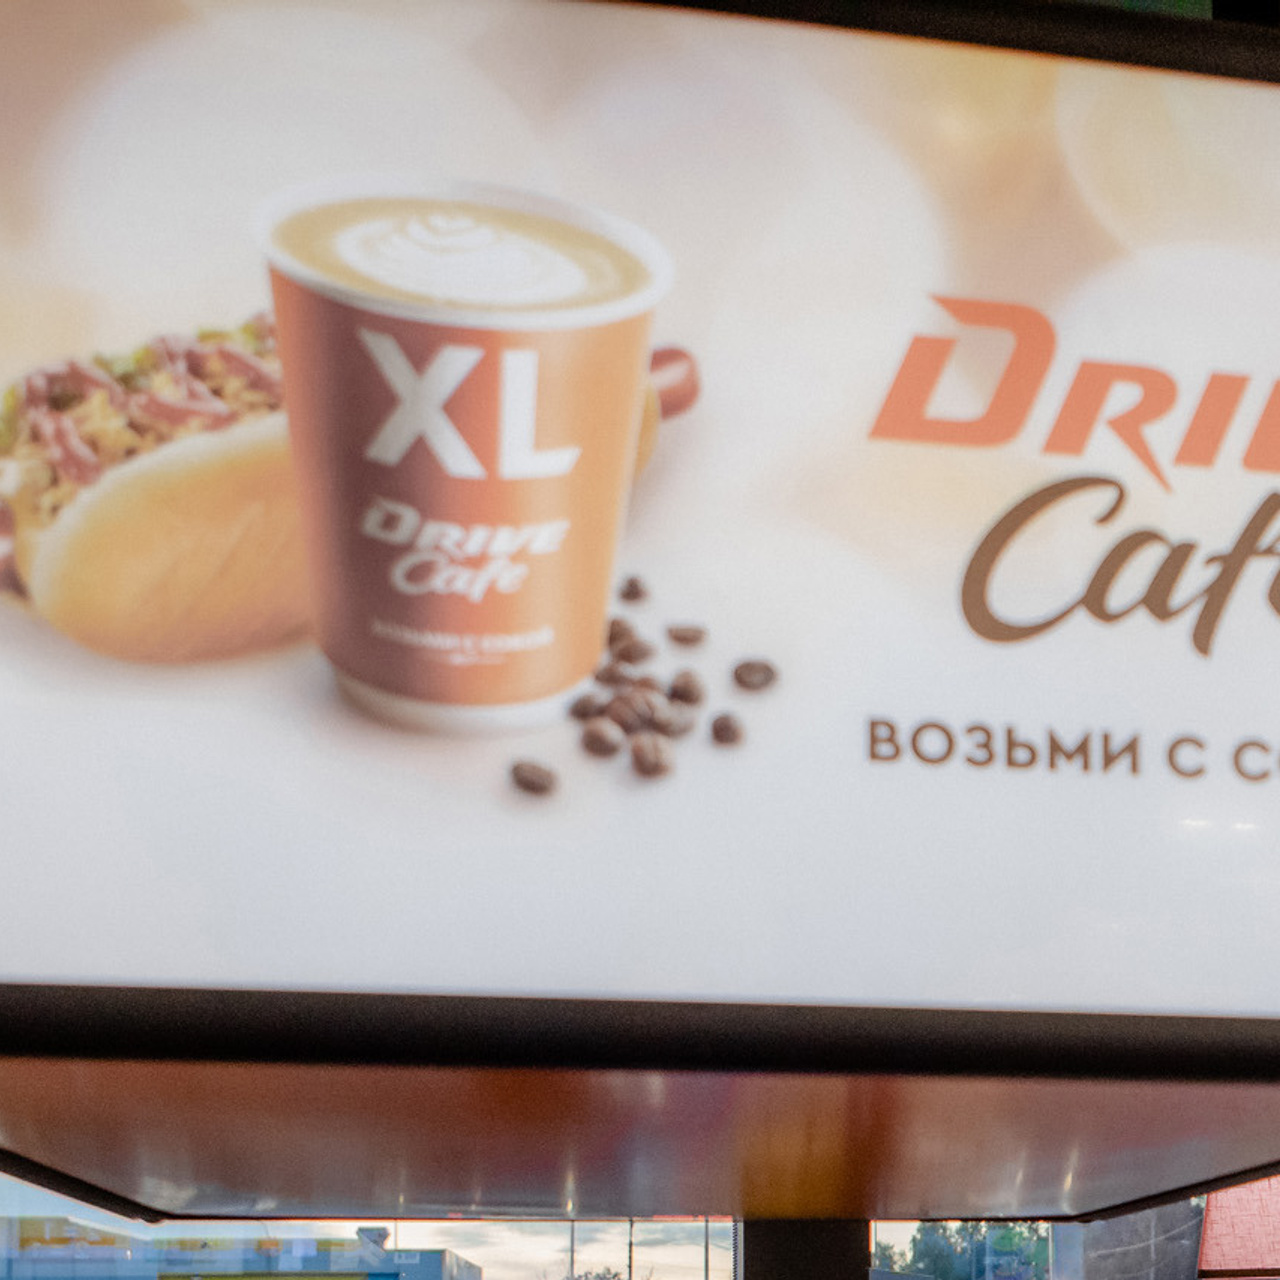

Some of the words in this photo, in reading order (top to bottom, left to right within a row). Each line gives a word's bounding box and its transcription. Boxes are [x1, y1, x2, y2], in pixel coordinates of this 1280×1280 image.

[358, 326, 583, 481] XL
[390, 552, 530, 603] Cafe
[867, 719, 1141, 777] ВОЗЬМИ
[1166, 735, 1208, 778] С
